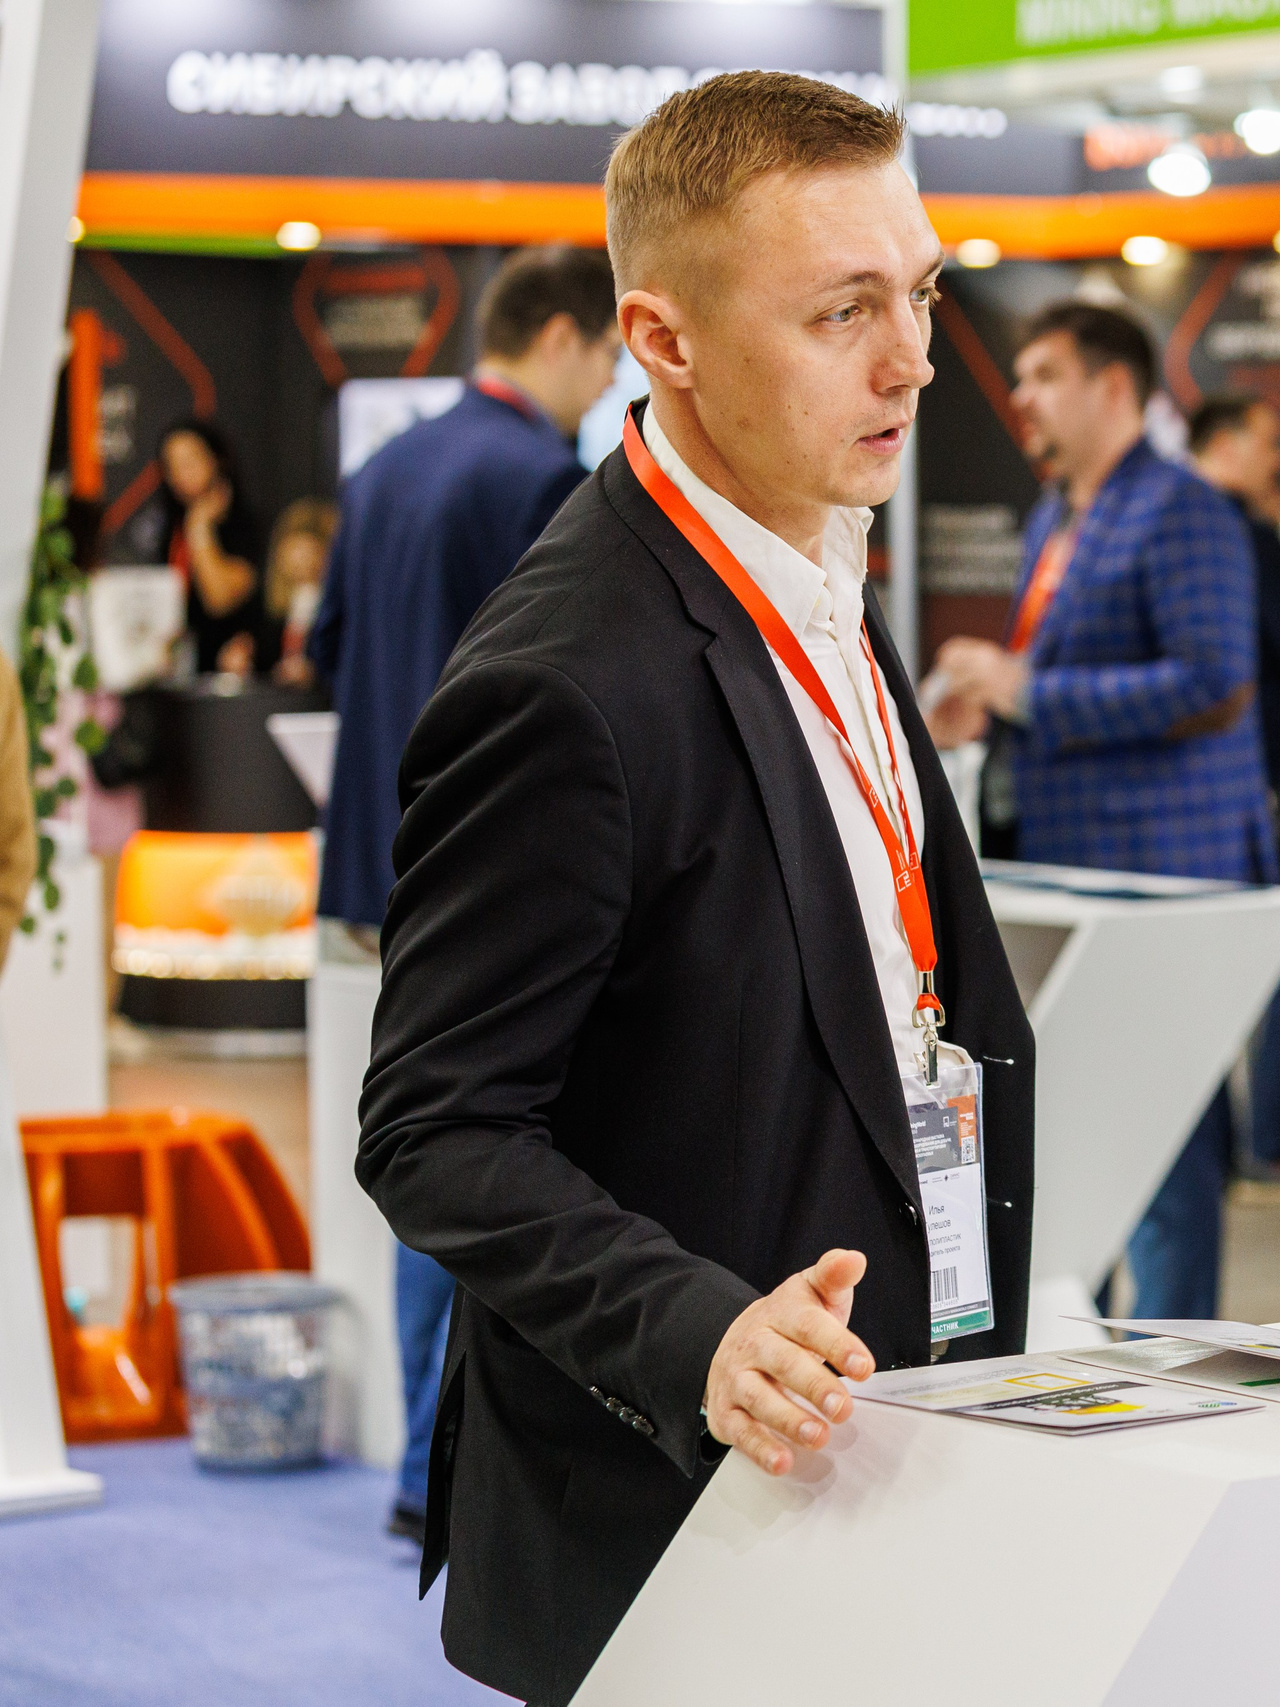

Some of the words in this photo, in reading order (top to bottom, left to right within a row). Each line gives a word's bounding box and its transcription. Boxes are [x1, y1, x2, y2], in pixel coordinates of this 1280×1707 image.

[928, 1205, 945, 1215] Илья
[927, 1219, 951, 1233] улешов
[931, 1321, 959, 1334] ЧАСТНИК
